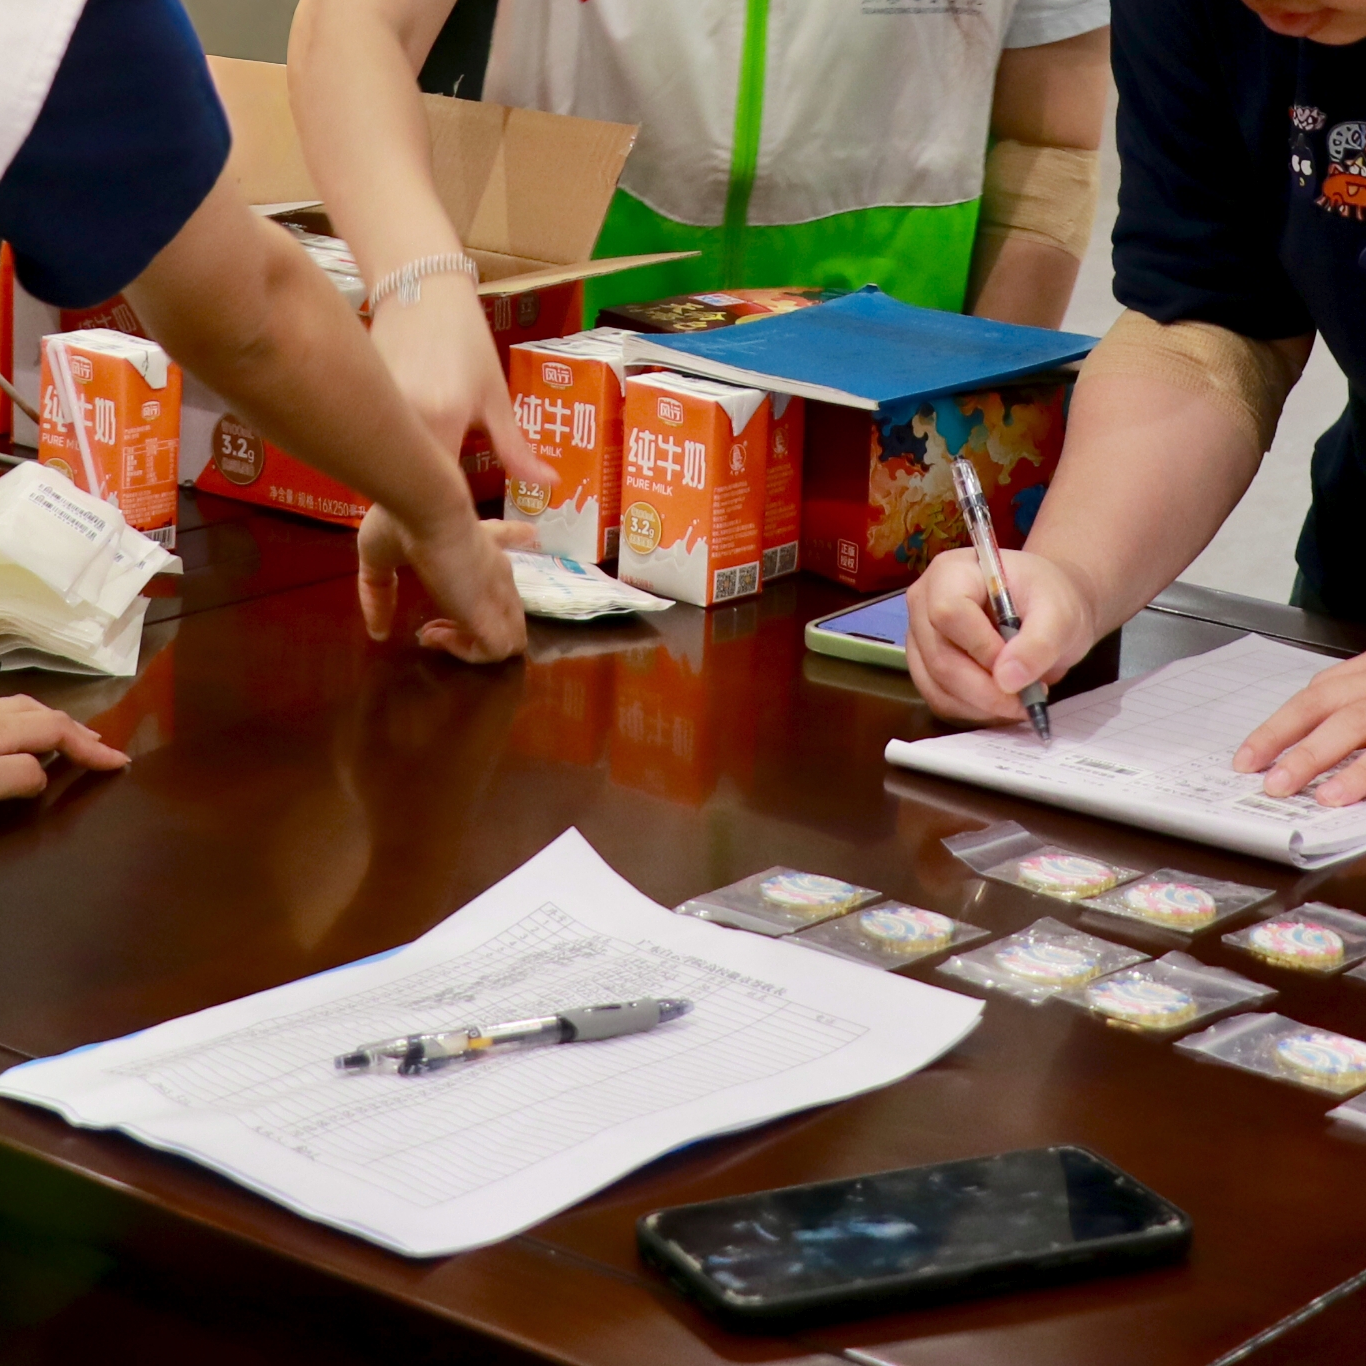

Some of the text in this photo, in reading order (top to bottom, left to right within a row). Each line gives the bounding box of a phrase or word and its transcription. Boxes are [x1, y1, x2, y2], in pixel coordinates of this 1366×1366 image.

[544, 367, 571, 384] 风行
[659, 401, 682, 421] 风行
[513, 393, 597, 450] 纯牛奶
[42, 433, 64, 447] PURE
[221, 433, 255, 463] 3.2g
[540, 444, 563, 458] MILK
[628, 427, 707, 491] 纯牛奶
[518, 480, 545, 500] 3.2g
[626, 476, 673, 497] PURE MILK
[630, 517, 655, 539] 3.2g
